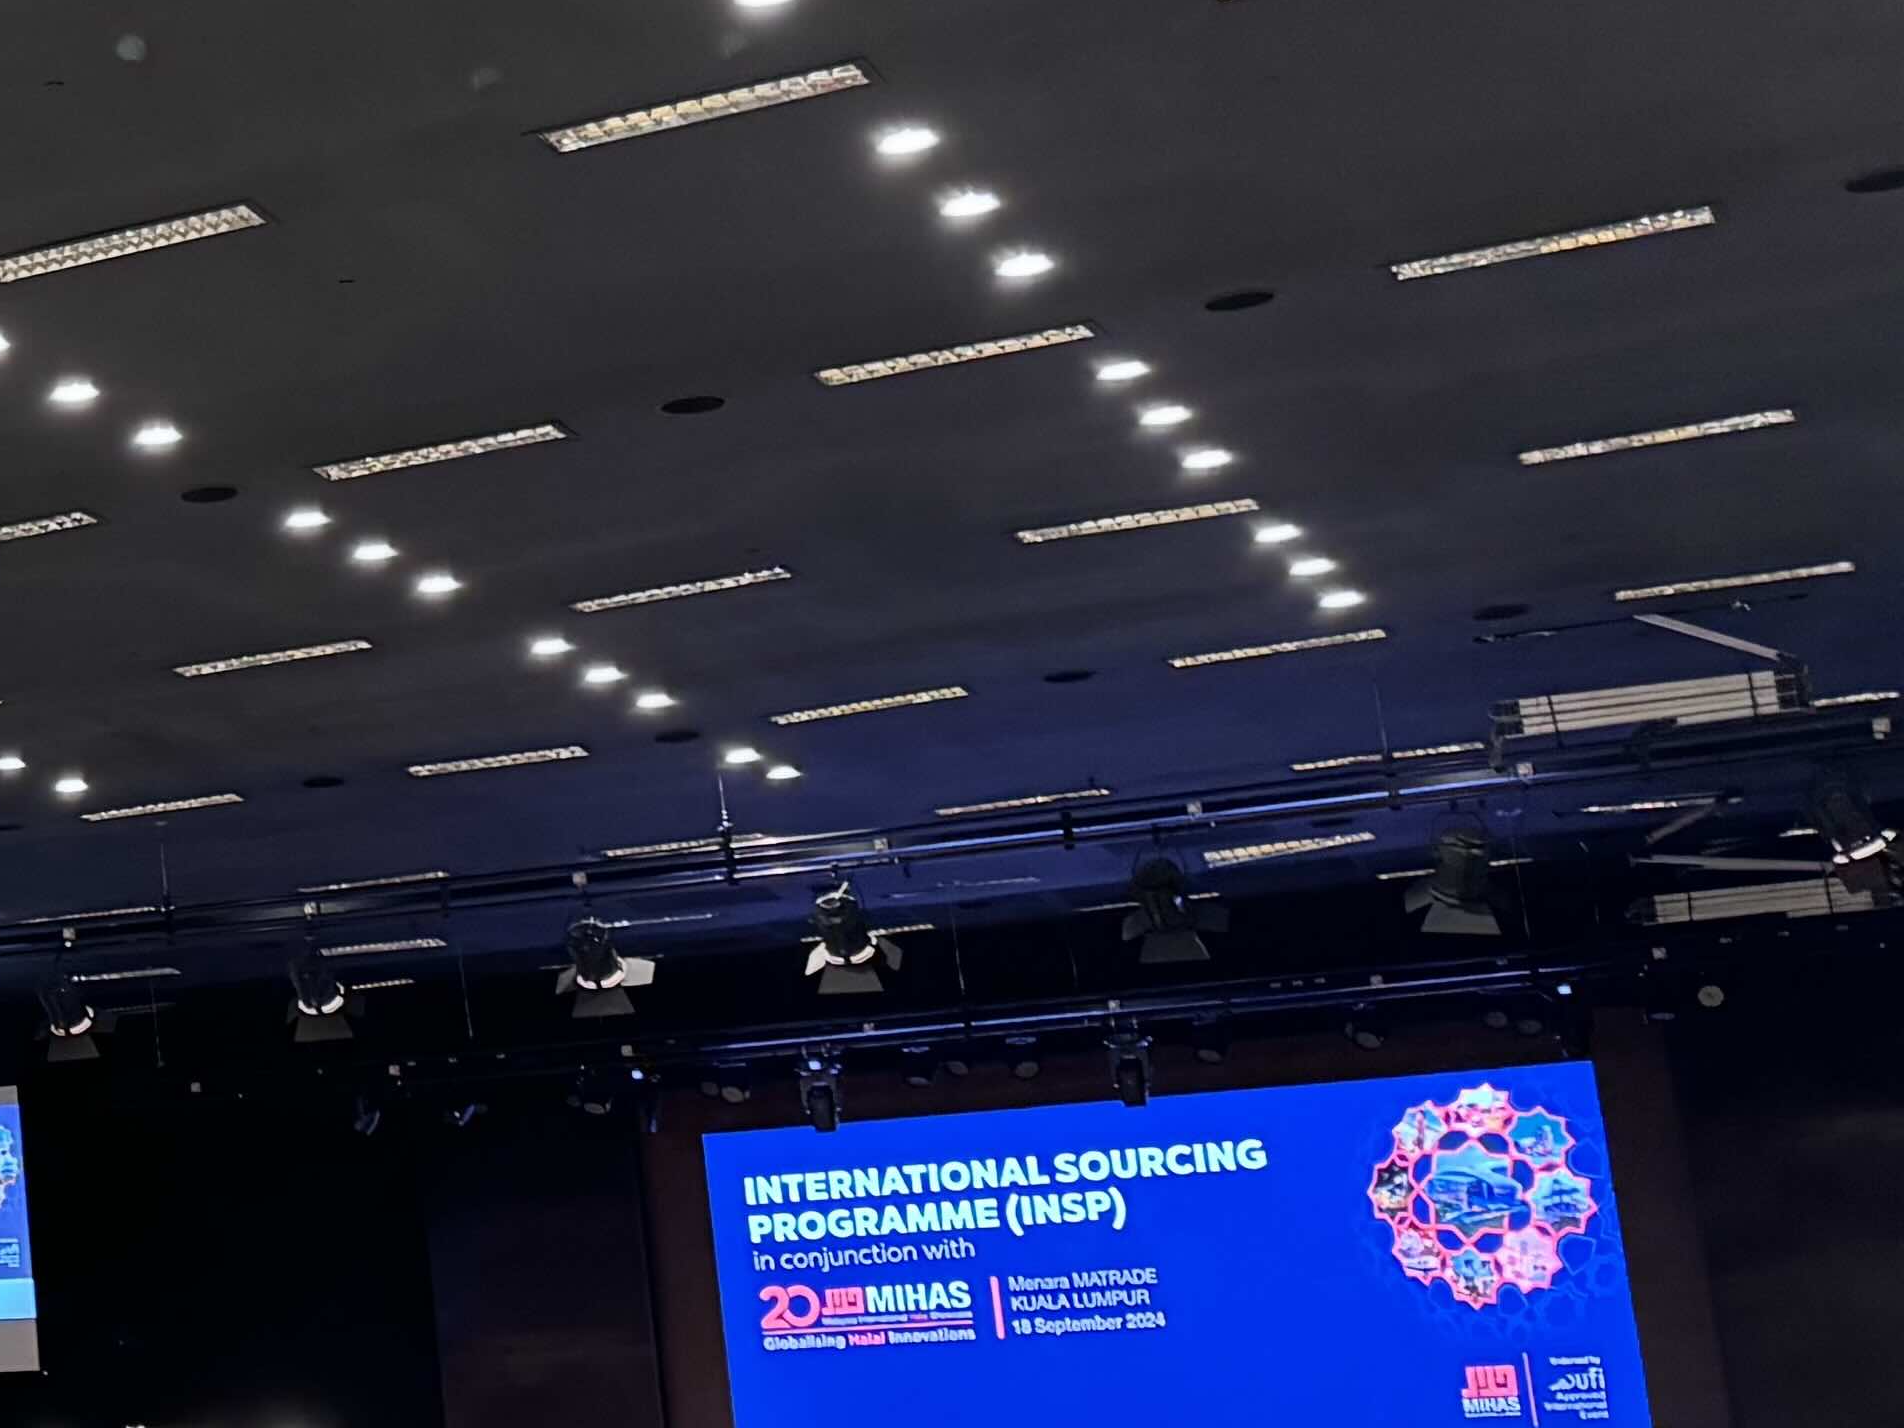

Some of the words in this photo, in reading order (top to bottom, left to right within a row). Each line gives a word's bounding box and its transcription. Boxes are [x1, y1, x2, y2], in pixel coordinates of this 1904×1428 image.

[743, 1156, 1051, 1205] INTERNATIONAL
[1053, 1139, 1268, 1183] SOURCING
[747, 1198, 1000, 1244] PROGRAMME
[1005, 1186, 1126, 1237] (INSP)
[752, 1250, 776, 1271] in
[779, 1242, 918, 1273] conjunction
[921, 1237, 976, 1260] with
[865, 1280, 972, 1313] MIHAS
[1008, 1274, 1070, 1292] Menara
[1072, 1268, 1158, 1288] MATRADE
[759, 1284, 822, 1329] 20
[1010, 1293, 1070, 1312] KUALA
[1072, 1289, 1151, 1310] LUMPUR
[1034, 1313, 1124, 1336] September
[1125, 1312, 1166, 1330] 2024
[1462, 1396, 1521, 1413] MIHAS
